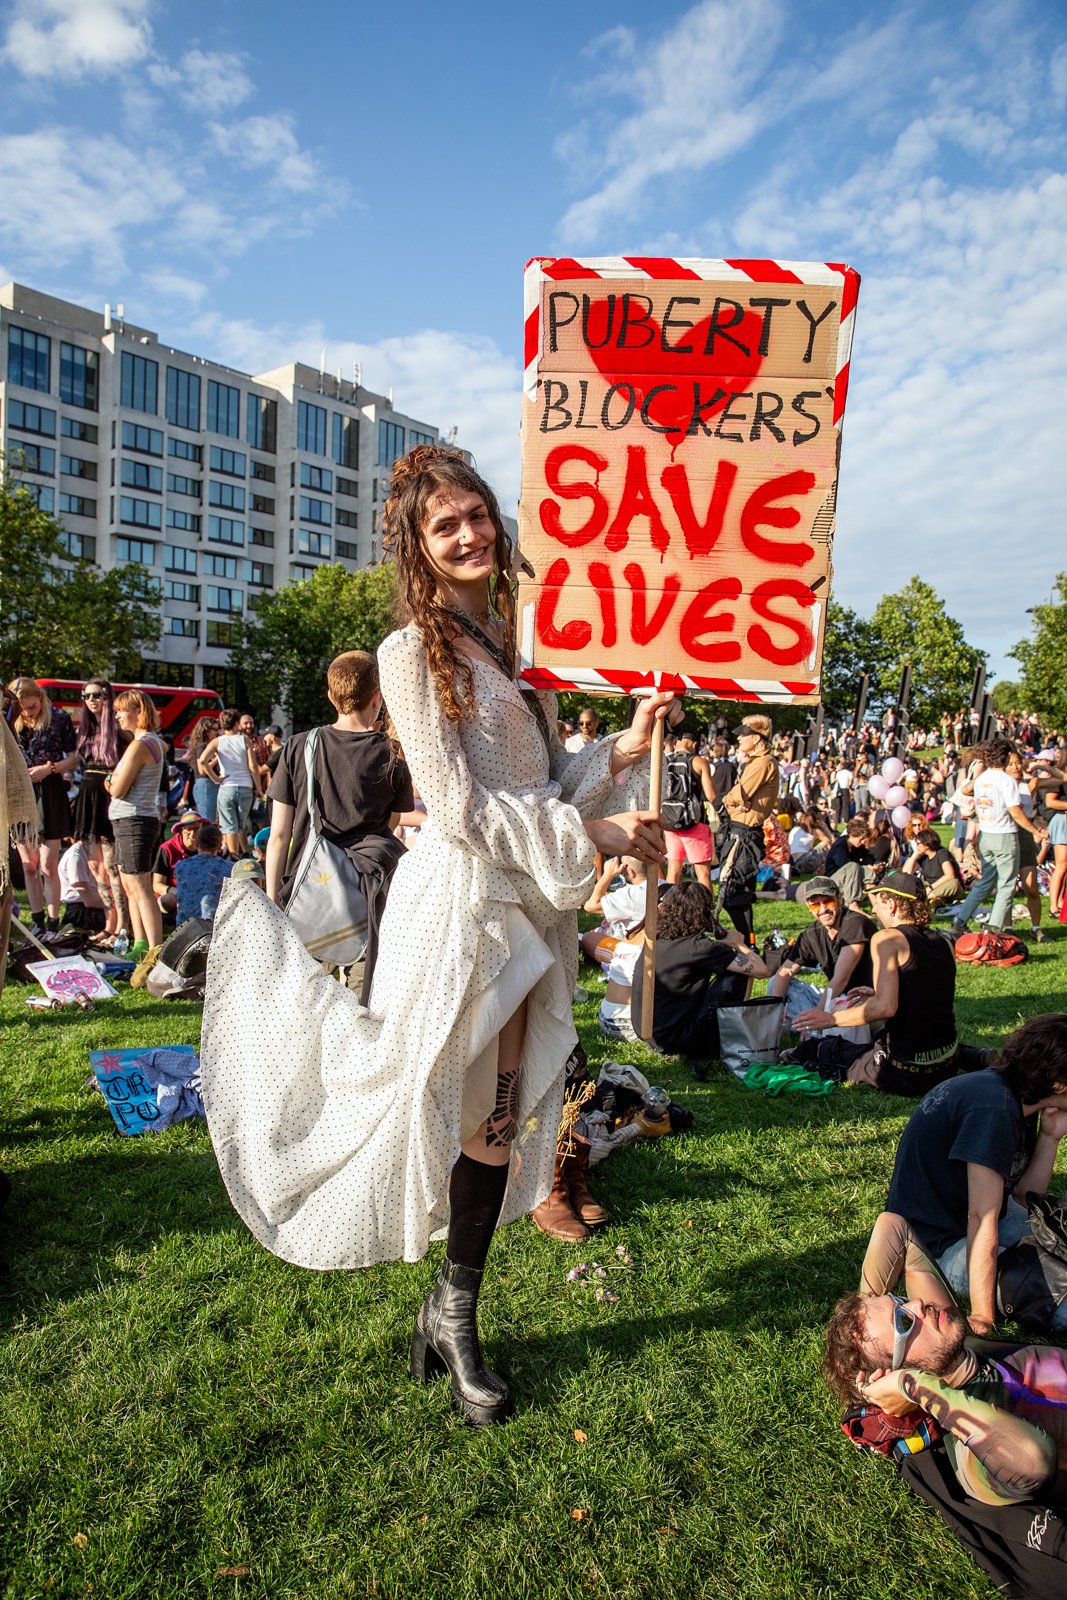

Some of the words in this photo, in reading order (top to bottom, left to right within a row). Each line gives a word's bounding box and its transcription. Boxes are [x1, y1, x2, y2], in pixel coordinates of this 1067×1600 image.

[548, 291, 837, 363] PUBERTY
[539, 444, 817, 567] SAVE
[537, 558, 818, 666] LIVES
[98, 1071, 157, 1101] TR
